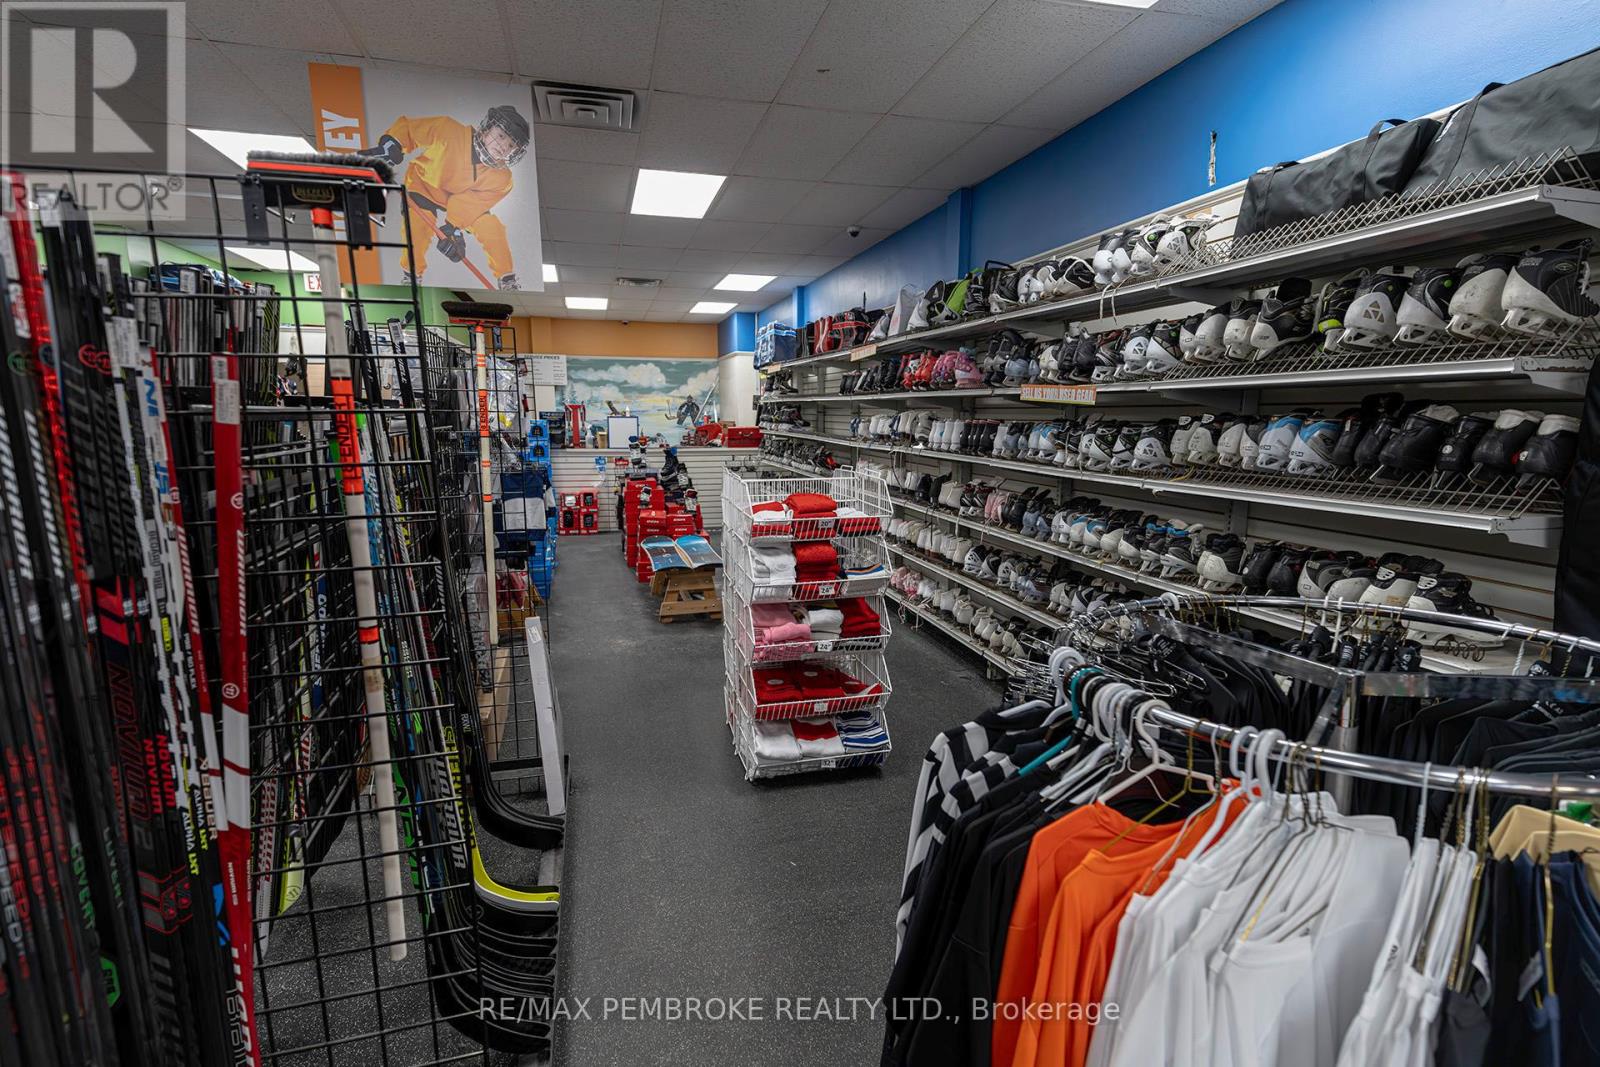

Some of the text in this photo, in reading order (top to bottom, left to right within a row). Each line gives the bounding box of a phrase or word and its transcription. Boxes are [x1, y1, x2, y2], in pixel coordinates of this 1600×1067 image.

[1022, 387, 1033, 399] SELL
[1043, 388, 1058, 400] YOUR
[1060, 389, 1075, 401] USED
[1077, 389, 1094, 402] GEAR
[143, 737, 164, 815] NOVIUM
[156, 733, 177, 808] NOVIUM
[193, 788, 209, 852] ALPHA LXT
[201, 772, 218, 842] BAUER
[435, 759, 467, 870] WARRIOR
[181, 811, 200, 876] ALPHA LXT
[70, 841, 96, 930] COVERT
